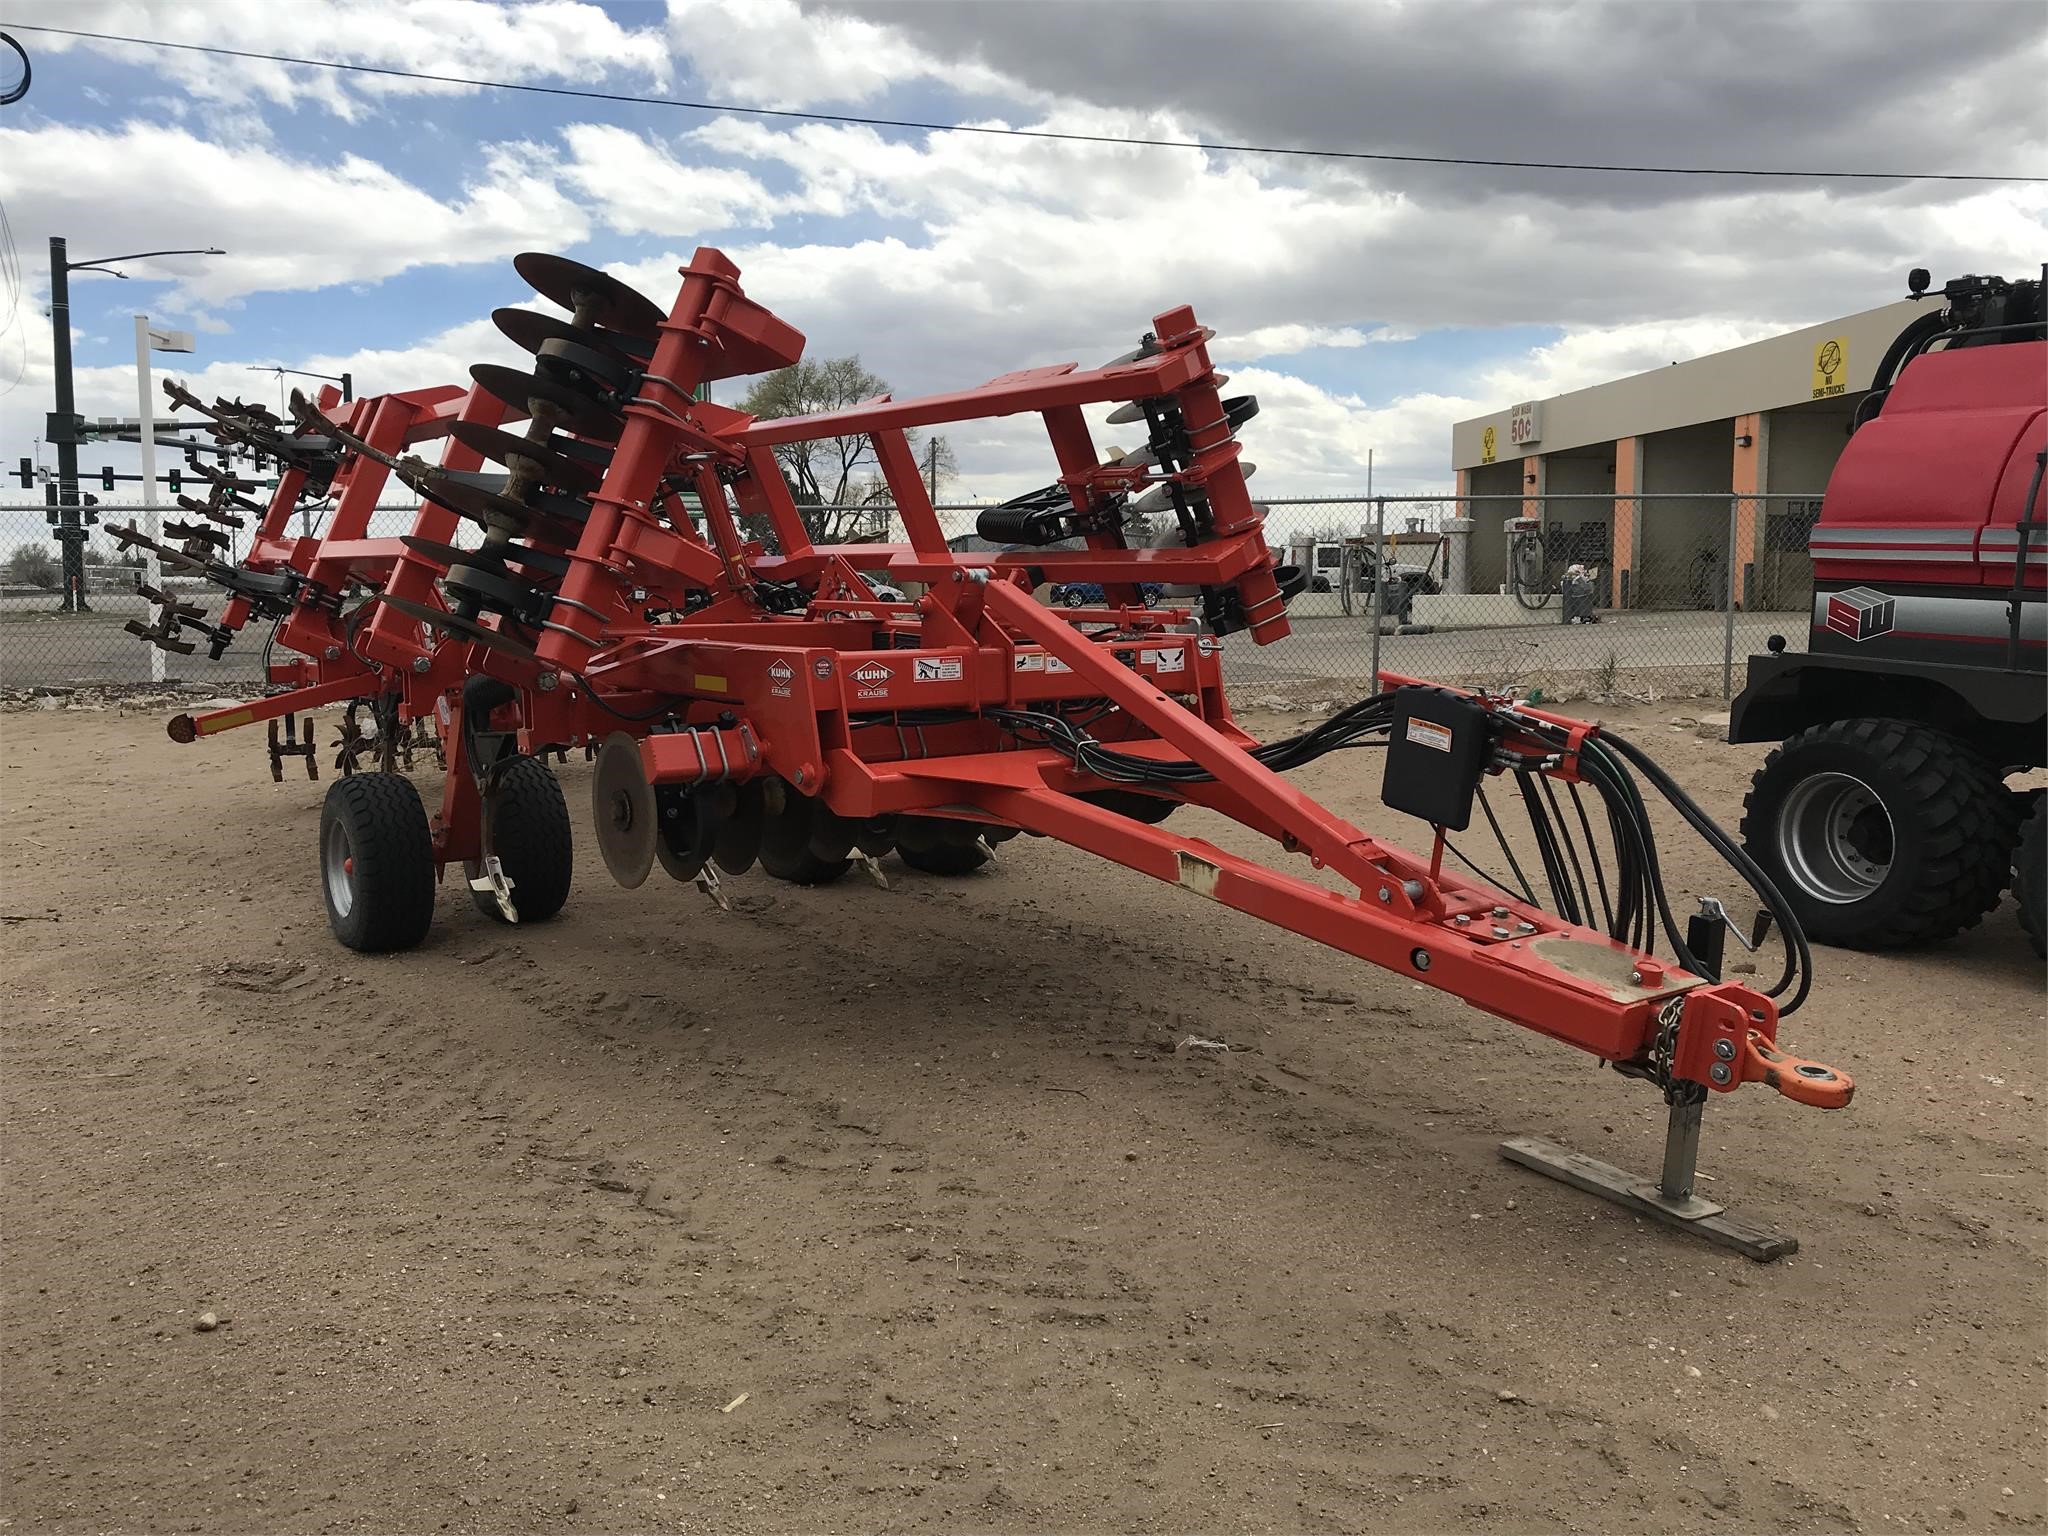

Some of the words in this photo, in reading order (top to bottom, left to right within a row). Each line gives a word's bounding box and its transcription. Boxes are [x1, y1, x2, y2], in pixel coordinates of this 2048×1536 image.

[1825, 375, 1833, 385] NO
[1812, 384, 1846, 399] SEMI-TRUCKS
[1512, 407, 1520, 418] CAR
[1521, 403, 1532, 416] WASH
[771, 667, 791, 679] KUHN
[857, 669, 888, 680] KUHN
[771, 687, 791, 696] KRAUSE
[857, 689, 889, 698] KRAUSE
